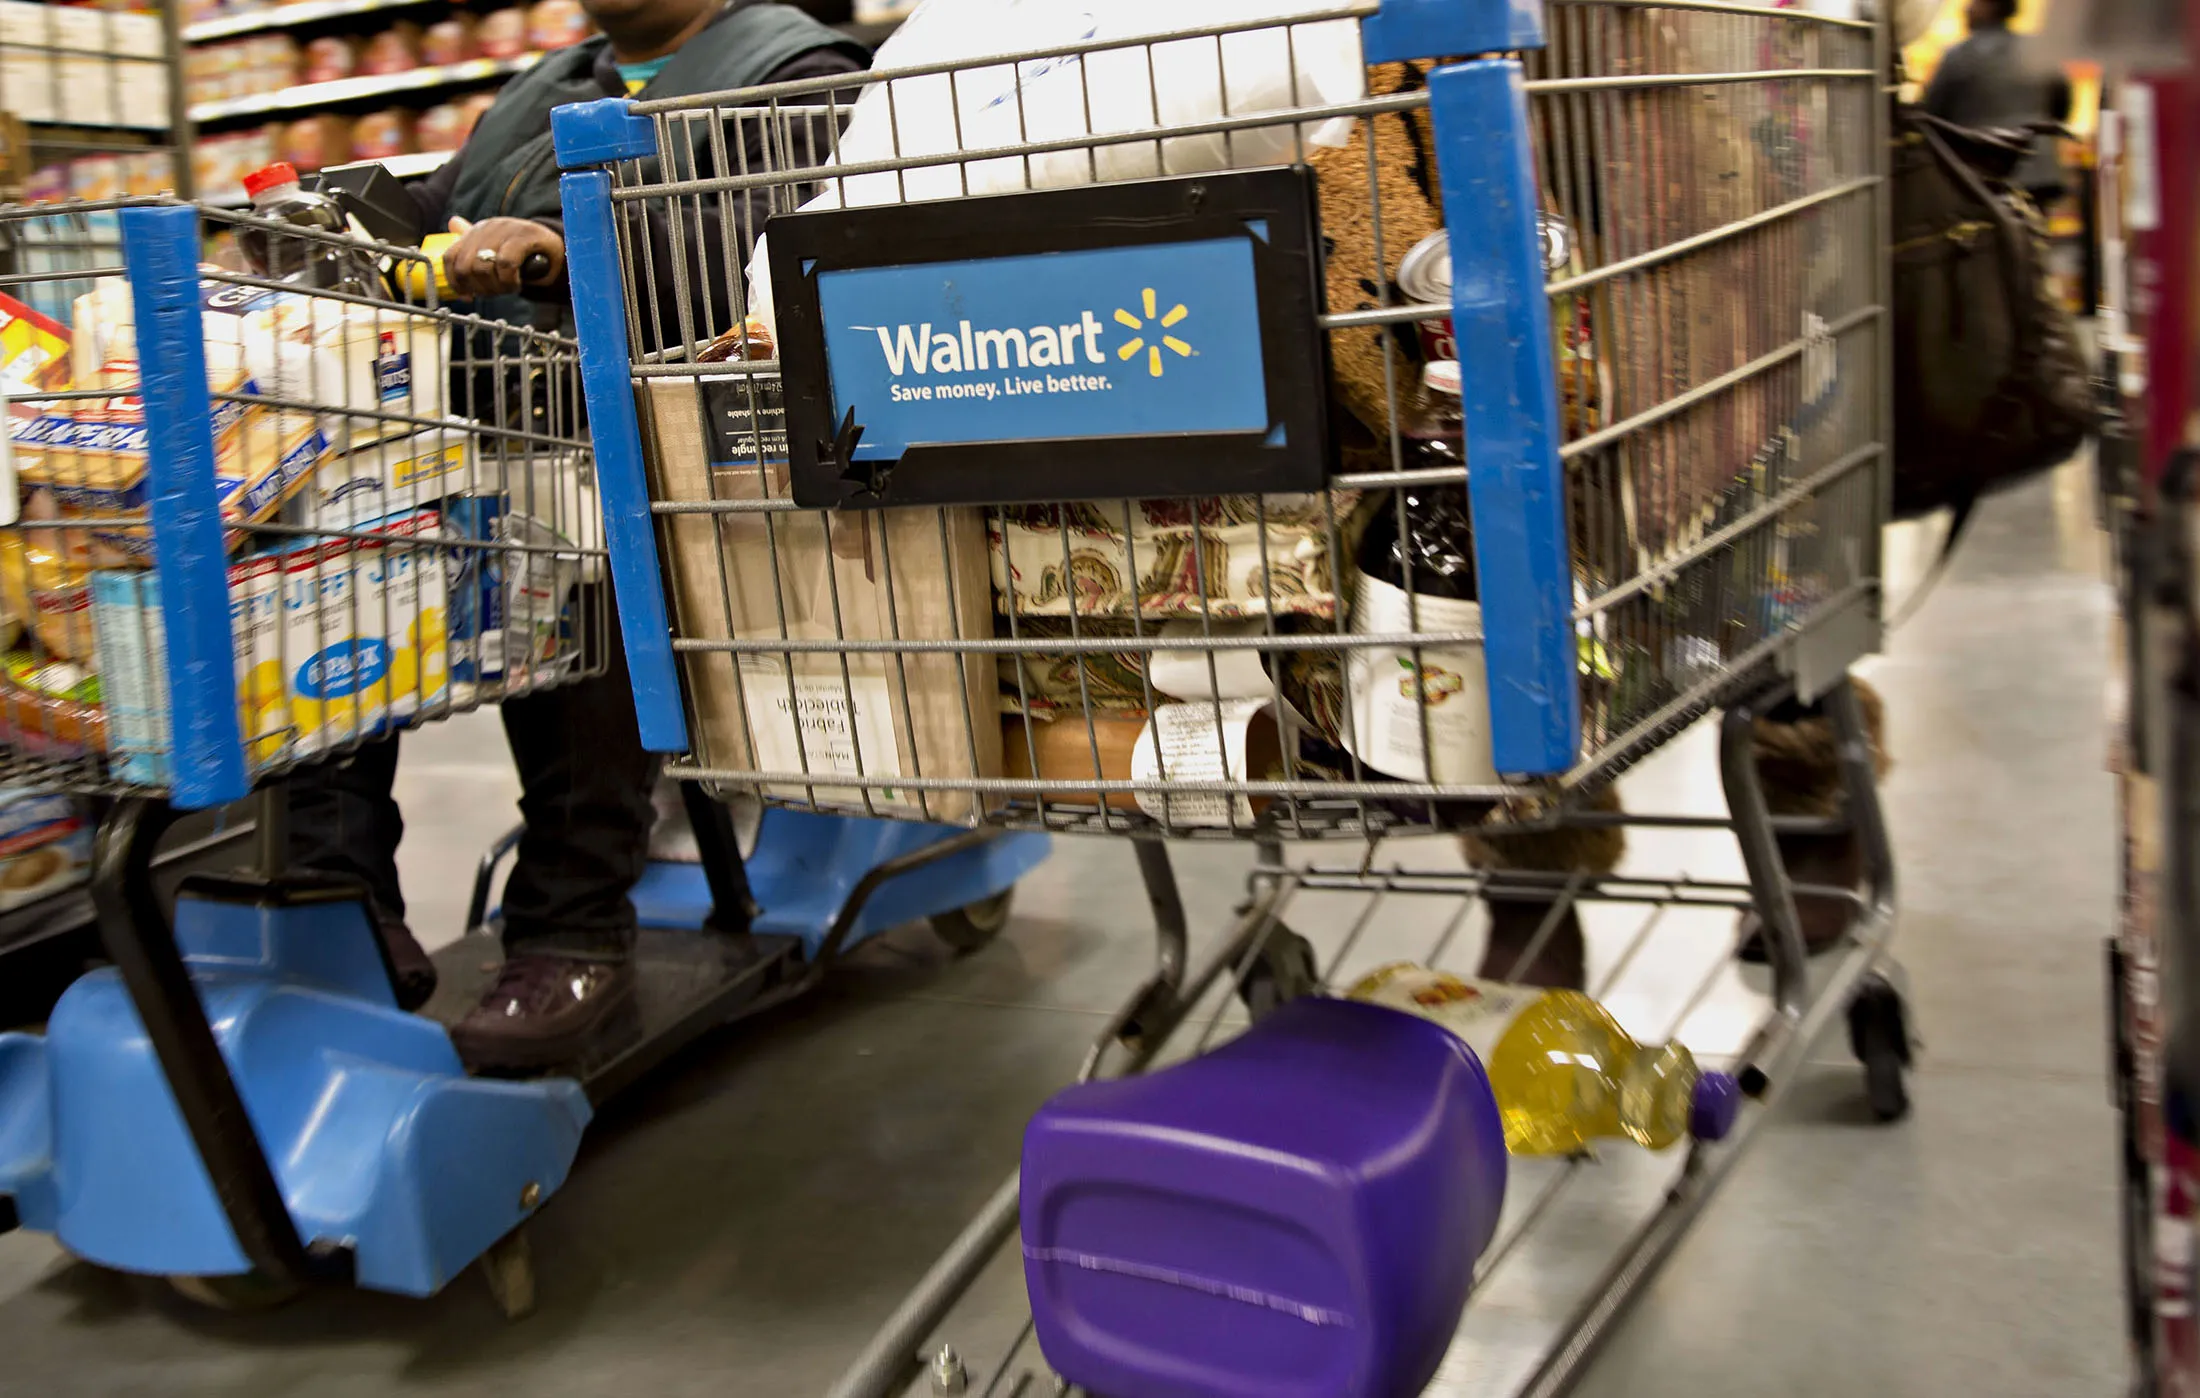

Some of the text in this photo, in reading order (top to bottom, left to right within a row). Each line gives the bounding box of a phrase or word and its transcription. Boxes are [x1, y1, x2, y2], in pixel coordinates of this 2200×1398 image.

[876, 310, 1106, 376] Walmart
[891, 374, 1113, 402] Save money. Live better.
[762, 407, 785, 417] achine
[737, 436, 771, 444] recngular
[731, 443, 777, 456] recangle
